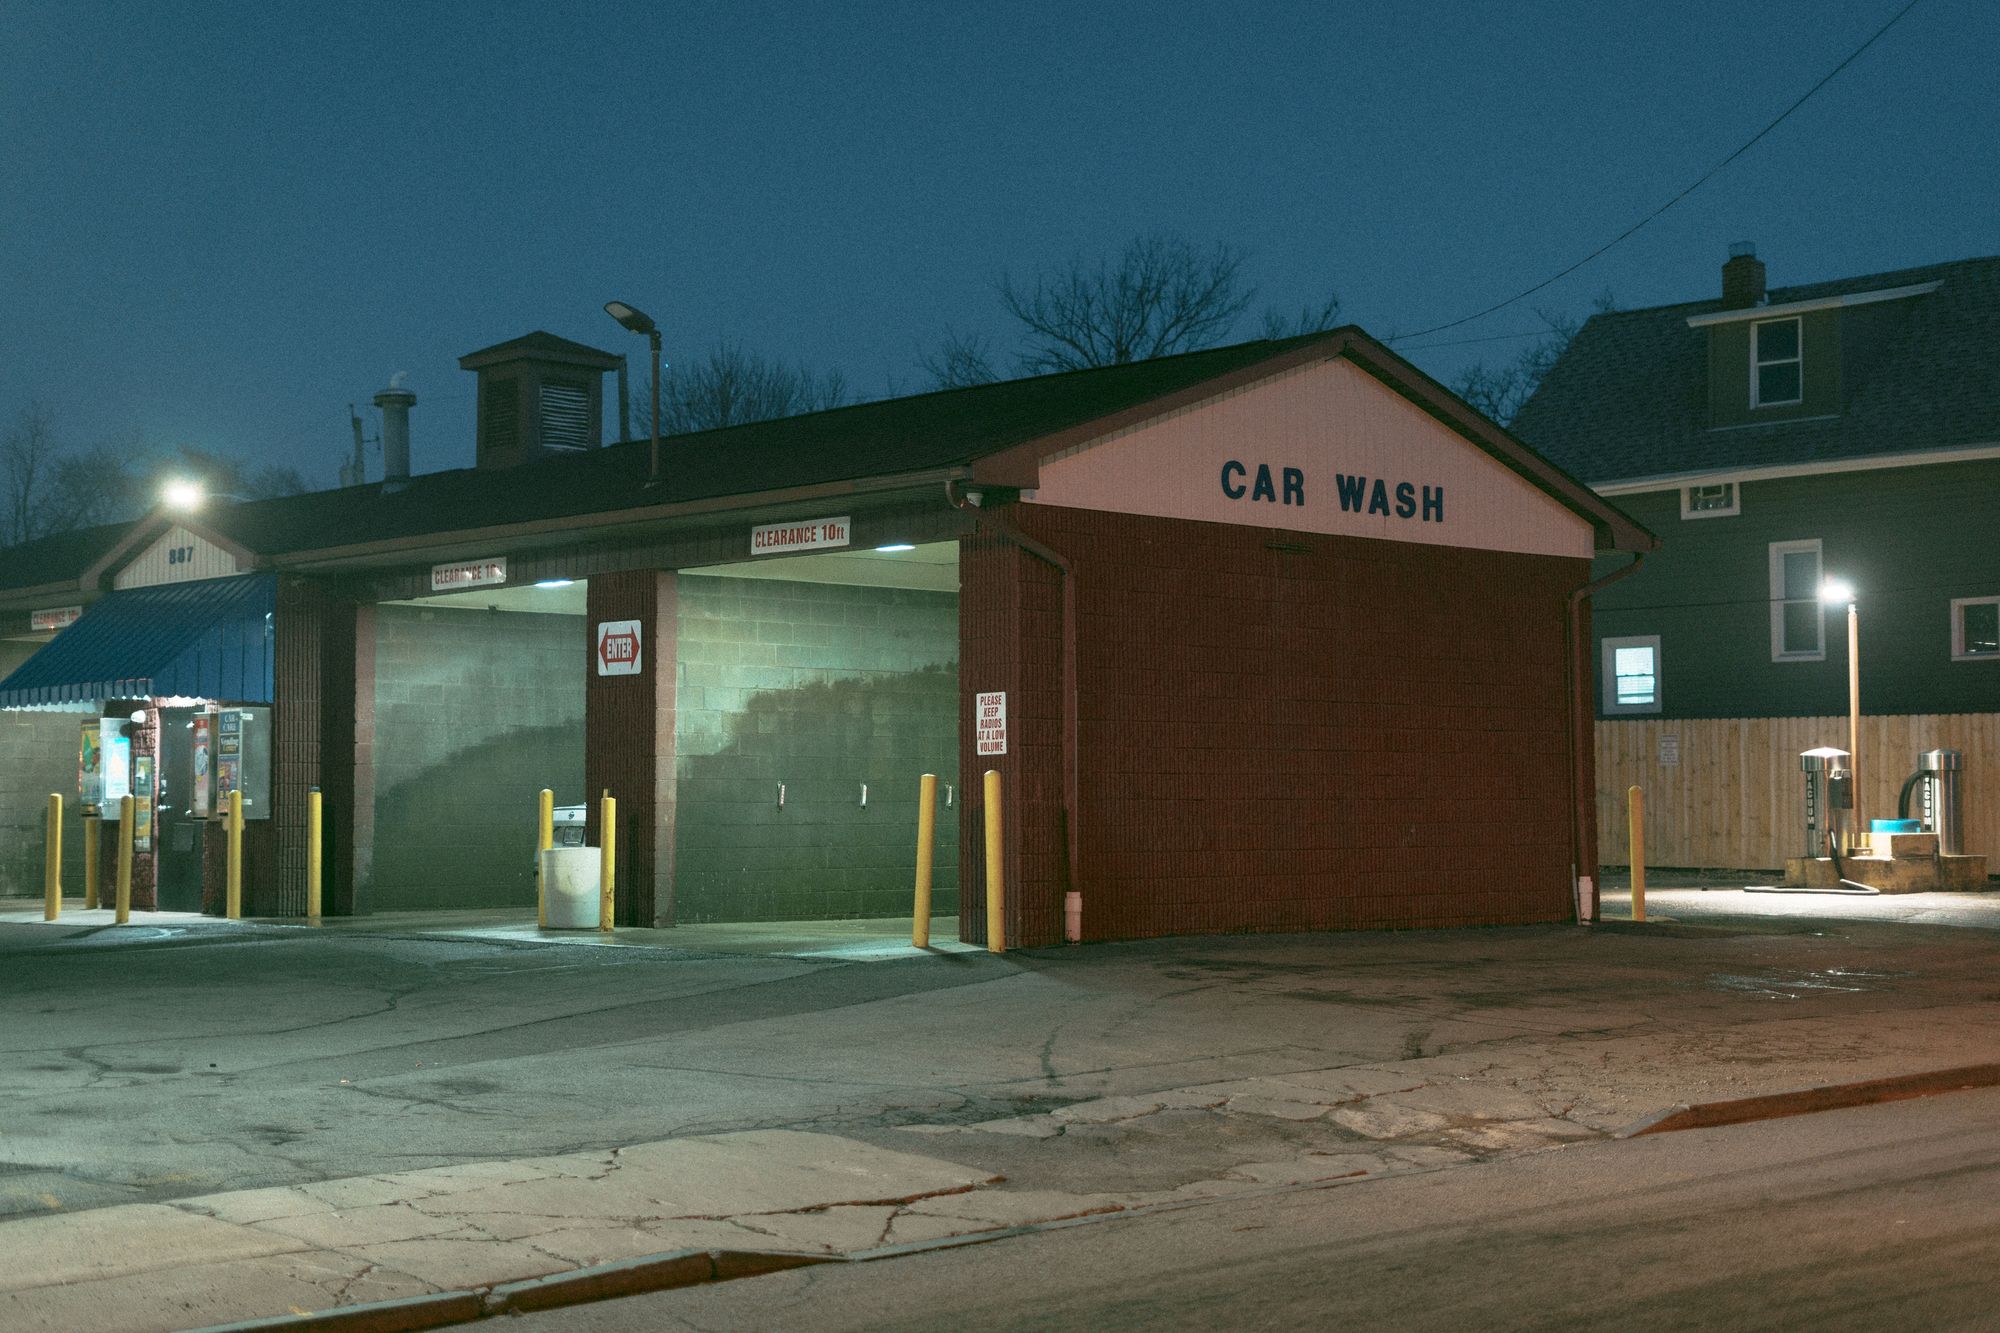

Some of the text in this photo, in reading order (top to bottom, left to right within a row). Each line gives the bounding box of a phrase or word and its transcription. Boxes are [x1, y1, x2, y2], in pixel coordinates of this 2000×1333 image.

[1221, 460, 1443, 522] CAR WASH
[755, 523, 844, 548] CLEARANCE 10ft
[607, 638, 632, 659] ENTER
[980, 695, 1002, 706] PLEASE
[983, 707, 999, 717] KEEP
[980, 719, 1002, 729] RADIOS
[978, 730, 1005, 741] AT A LOW
[980, 742, 1003, 752] VOLUME
[1807, 772, 1815, 824] VACUUM
